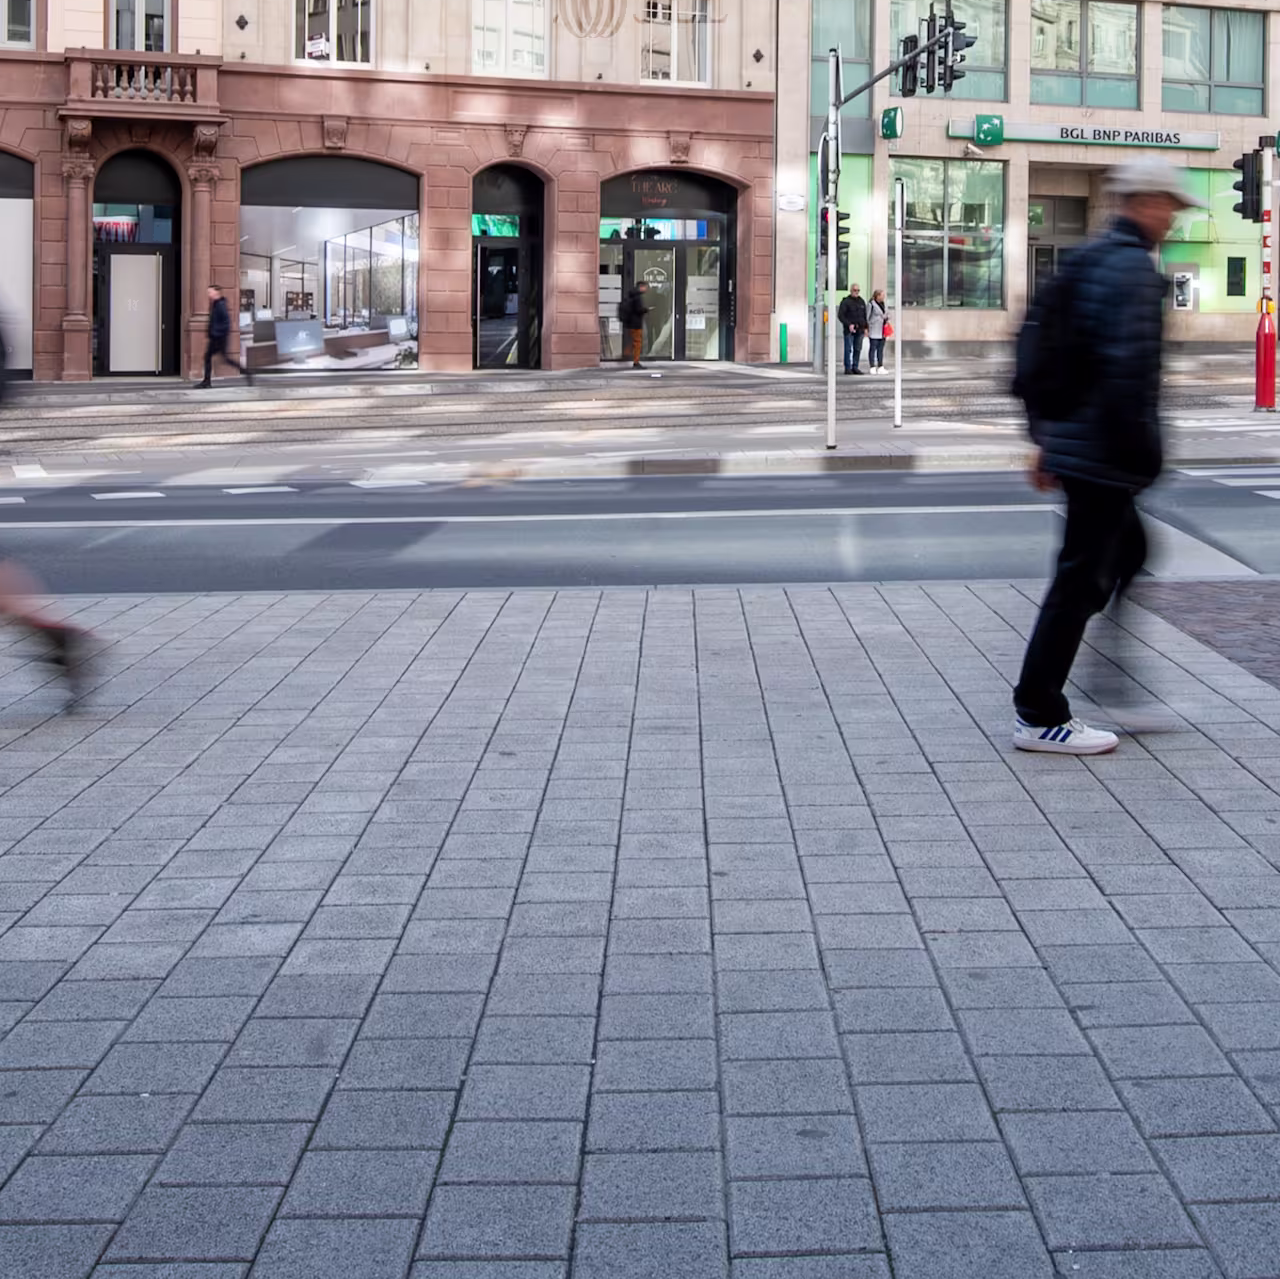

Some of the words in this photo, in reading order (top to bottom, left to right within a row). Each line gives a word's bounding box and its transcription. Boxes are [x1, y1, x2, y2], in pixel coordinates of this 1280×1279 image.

[1060, 127, 1088, 140] BGL
[1093, 129, 1121, 141] BNP
[1124, 131, 1180, 144] PARIBAS
